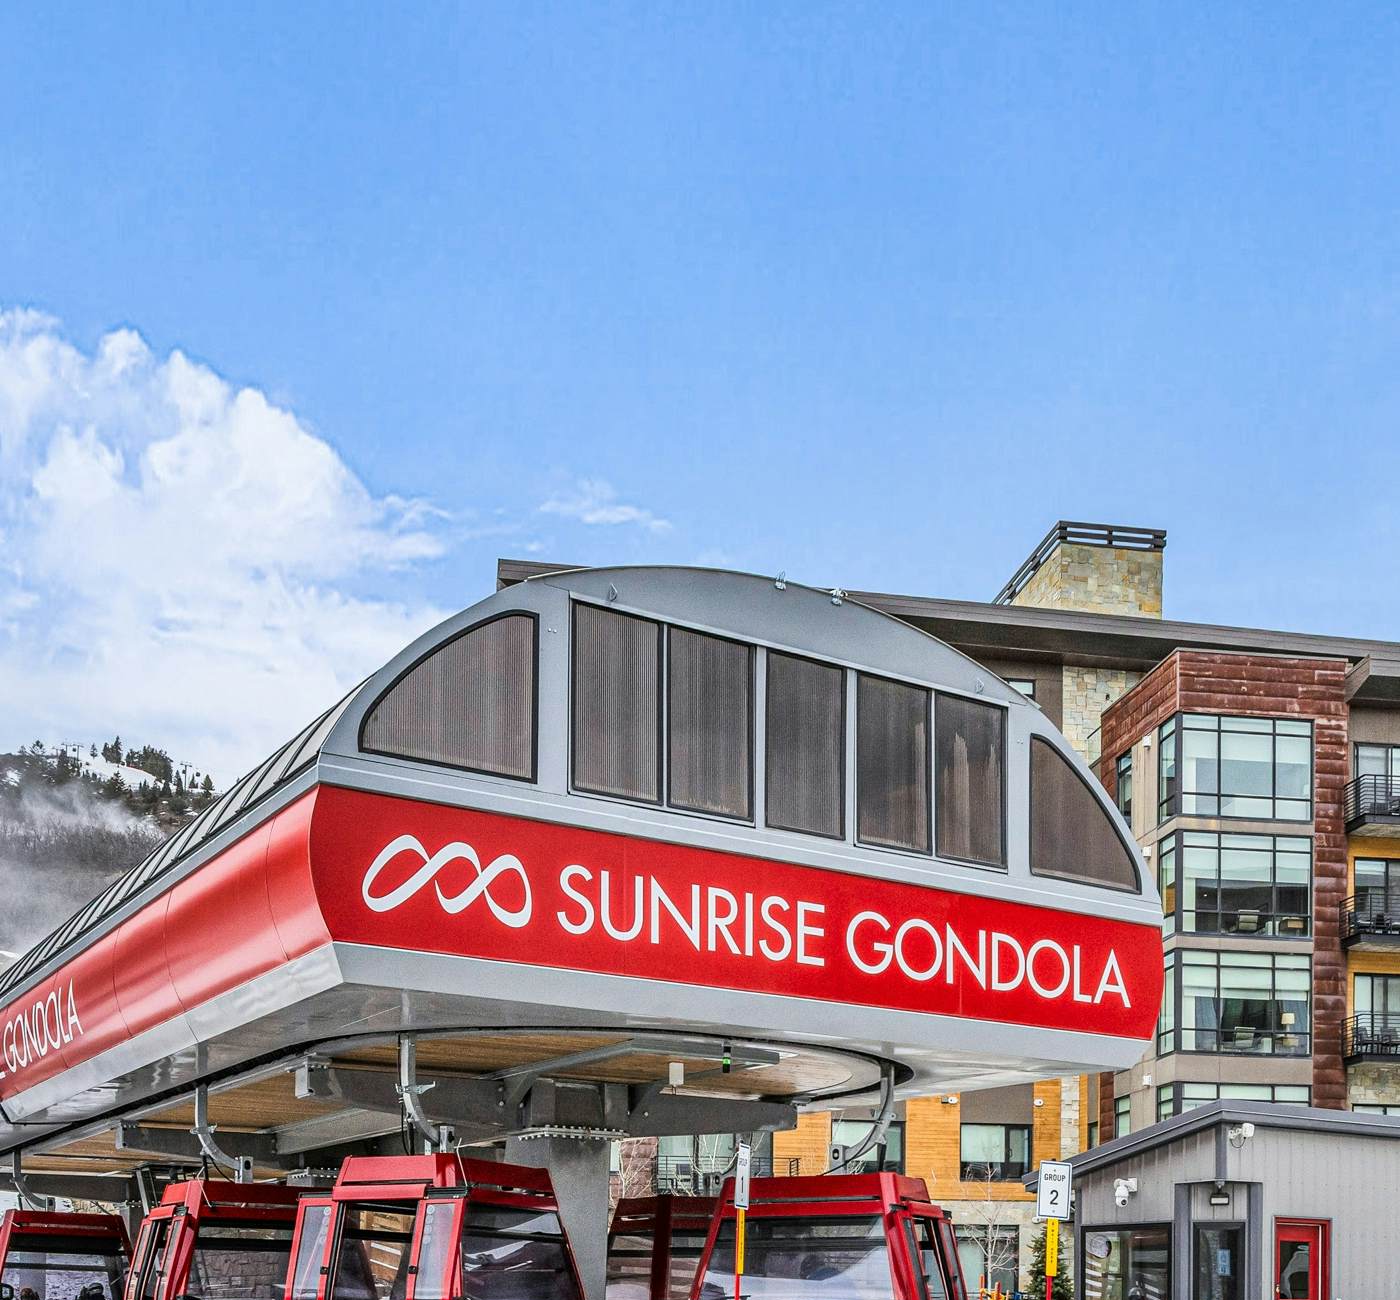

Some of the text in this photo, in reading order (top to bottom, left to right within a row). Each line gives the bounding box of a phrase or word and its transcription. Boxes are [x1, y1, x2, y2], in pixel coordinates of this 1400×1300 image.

[556, 864, 1131, 1008] SUNRISE GONDOLA
[3, 977, 84, 1073] GONDOLA
[1044, 1173, 1066, 1182] GROUP
[1049, 1189, 1060, 1206] 2
